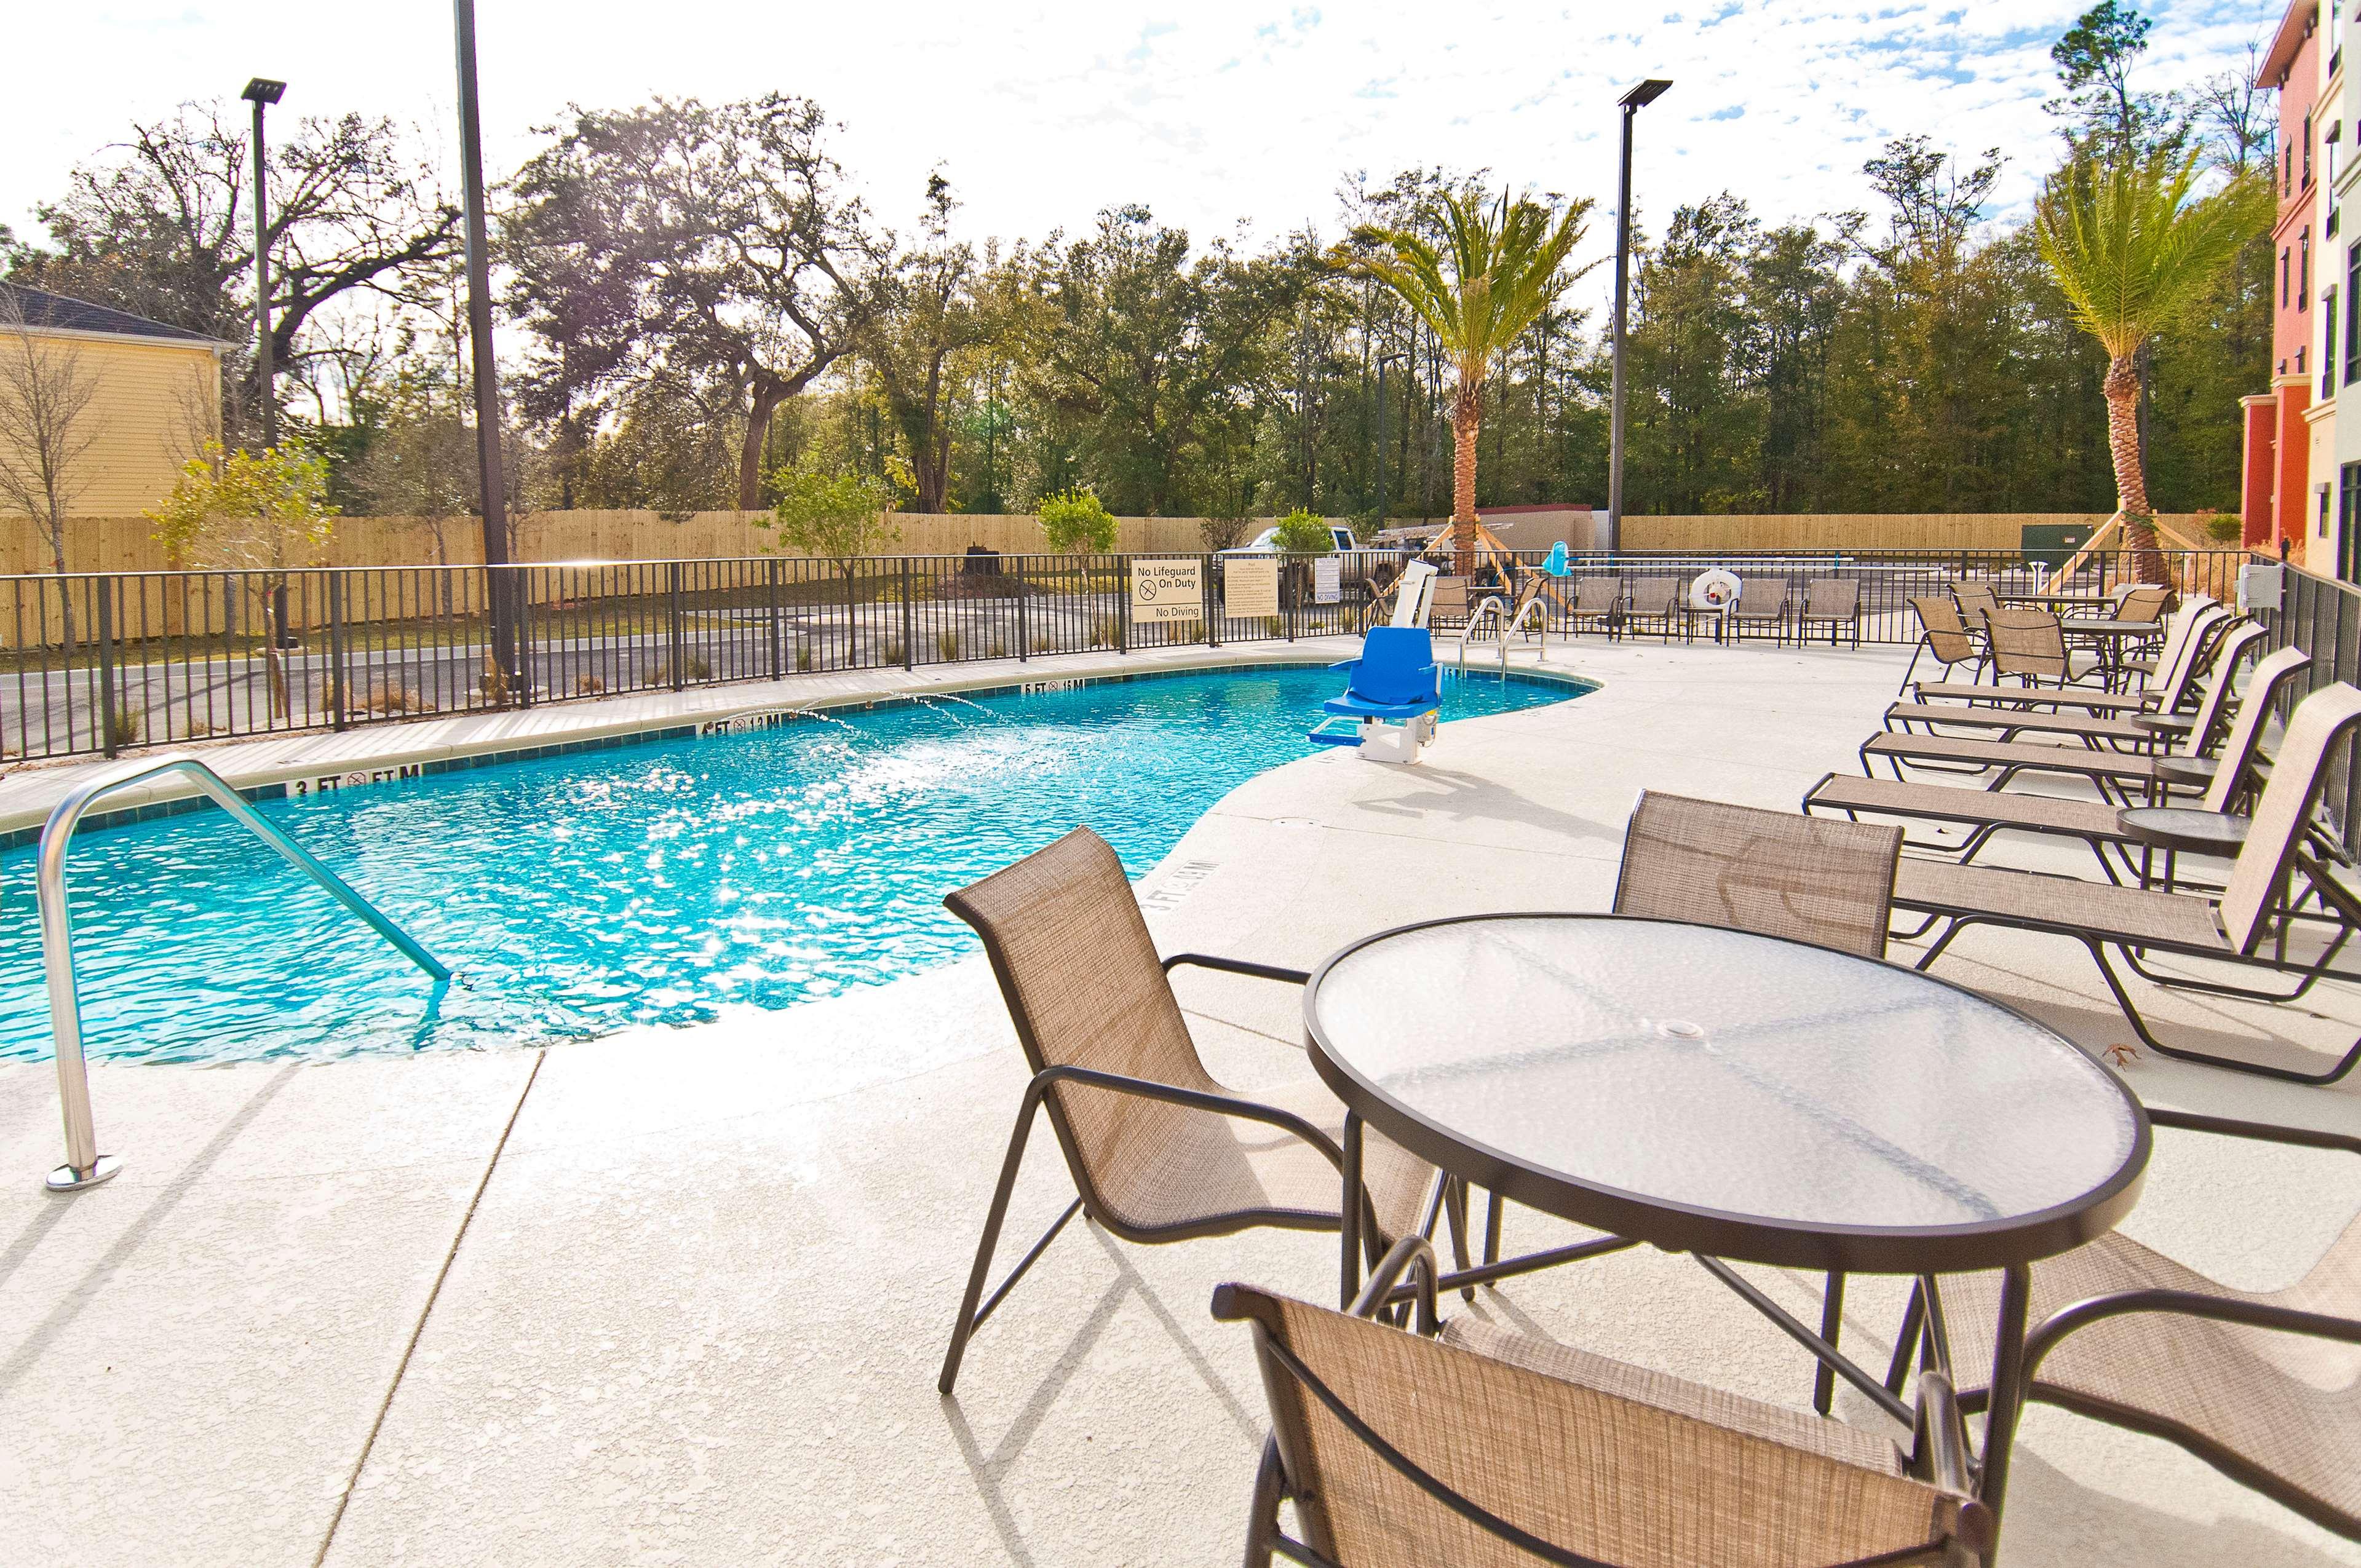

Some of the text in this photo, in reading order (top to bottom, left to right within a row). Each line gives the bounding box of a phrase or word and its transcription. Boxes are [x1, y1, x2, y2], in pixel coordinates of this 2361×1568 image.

[1138, 566, 1196, 578] No Lifeguard
[1159, 579, 1196, 589] On Duty
[1156, 606, 1199, 617] No Diving
[1035, 682, 1046, 693] FT
[1074, 678, 1083, 690] M
[715, 720, 730, 734] FT
[766, 713, 779, 728] M
[317, 775, 341, 792] FT
[399, 764, 419, 780] M
[1146, 890, 1186, 903] FT
